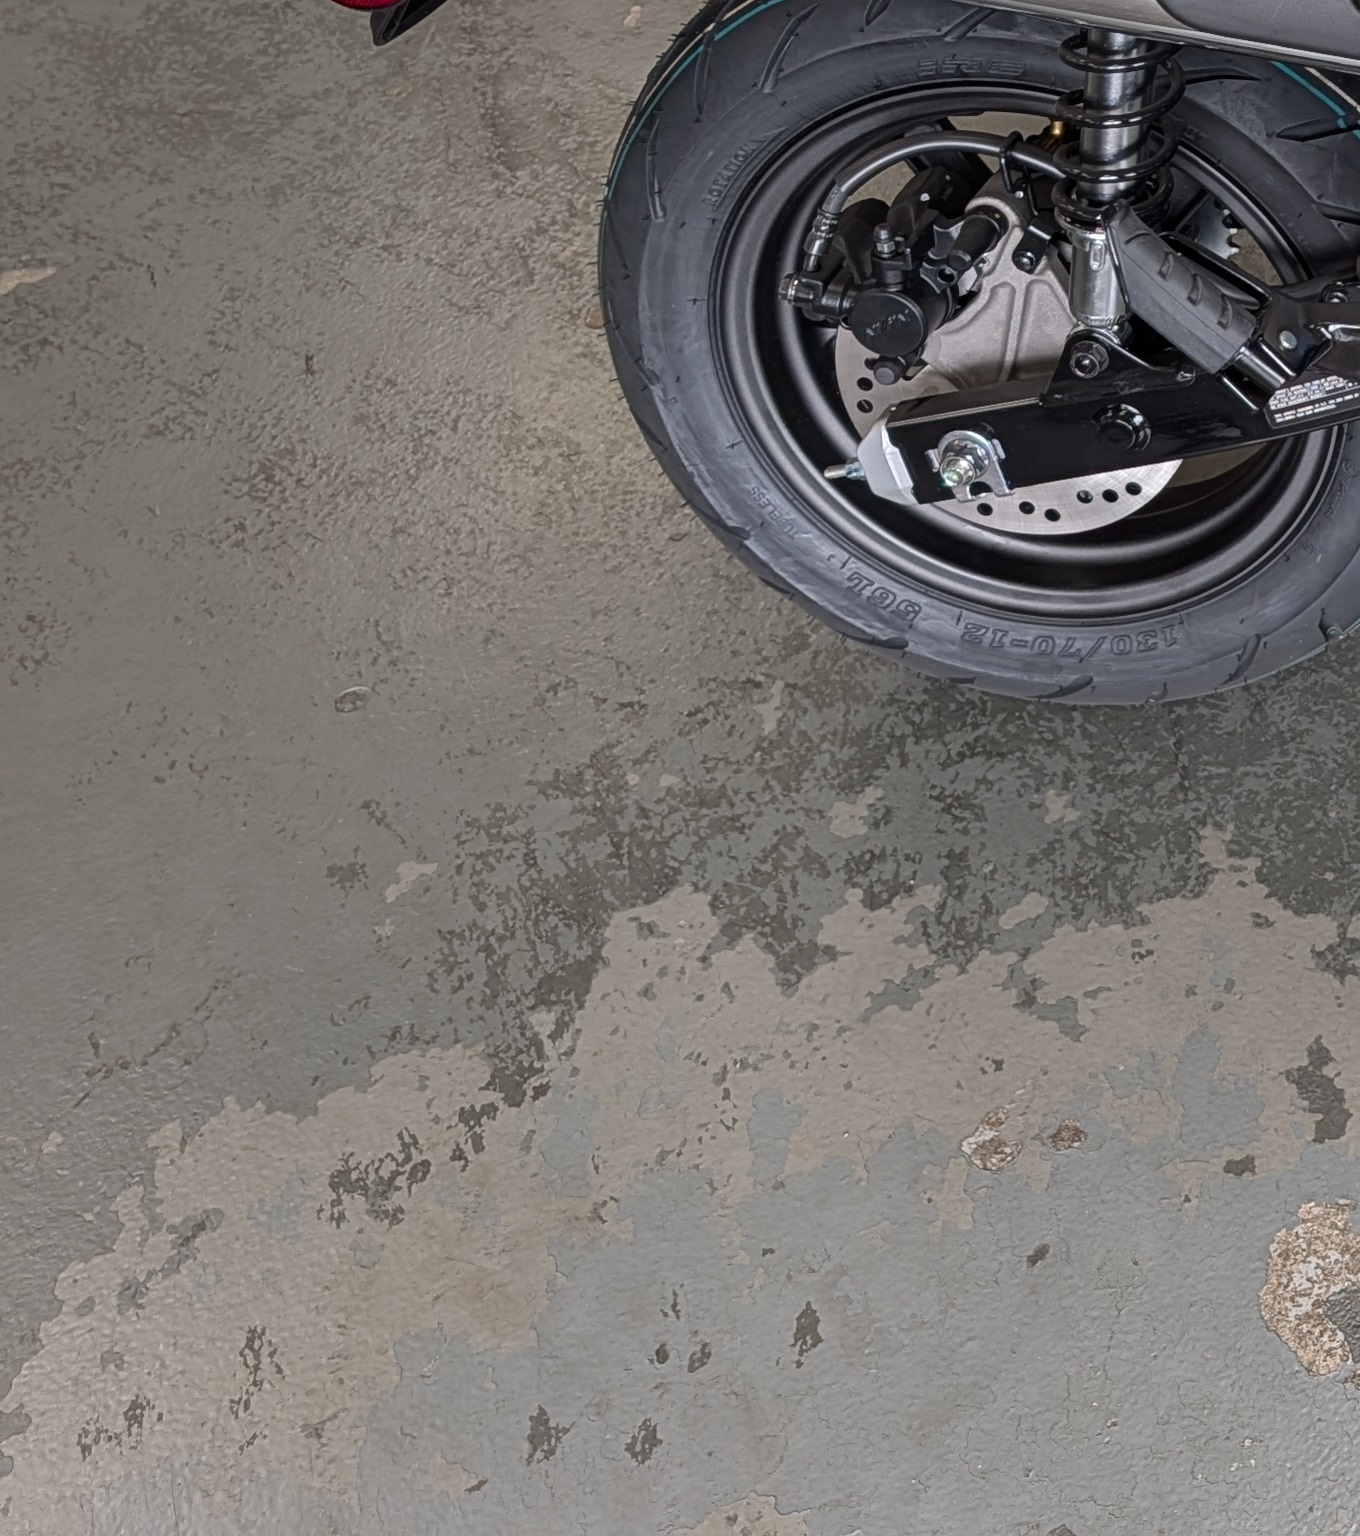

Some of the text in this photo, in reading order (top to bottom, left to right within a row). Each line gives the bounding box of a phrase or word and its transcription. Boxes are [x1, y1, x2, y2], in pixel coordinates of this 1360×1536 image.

[702, 142, 757, 206] ROTATION
[750, 484, 799, 539] TUBELESS
[846, 571, 1179, 662] 130/70-12 56L
